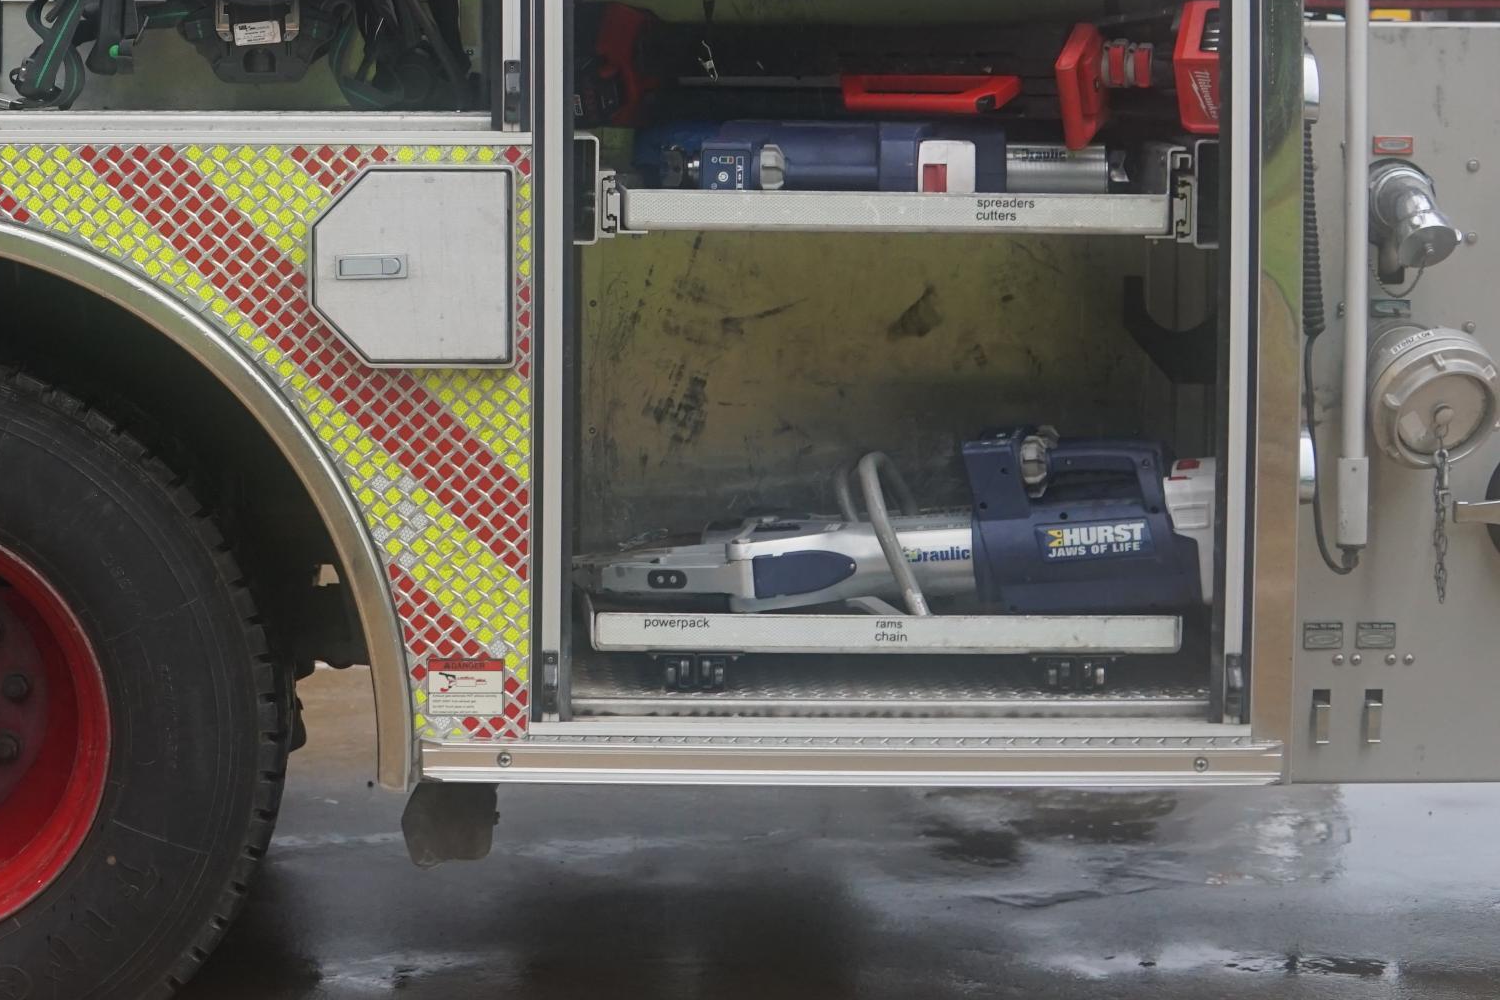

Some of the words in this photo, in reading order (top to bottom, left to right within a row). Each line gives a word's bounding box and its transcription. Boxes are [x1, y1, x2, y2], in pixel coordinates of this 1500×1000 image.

[977, 198, 1035, 209] spreaders
[976, 211, 1017, 221] cutters
[1062, 522, 1145, 547] HURST
[1048, 546, 1087, 558] JAWS
[1090, 544, 1107, 555] OF
[1112, 542, 1141, 553] LIFE
[644, 618, 710, 630] powerpack
[875, 619, 903, 630] rams
[875, 631, 908, 643] chain
[451, 661, 485, 670] DANGER
